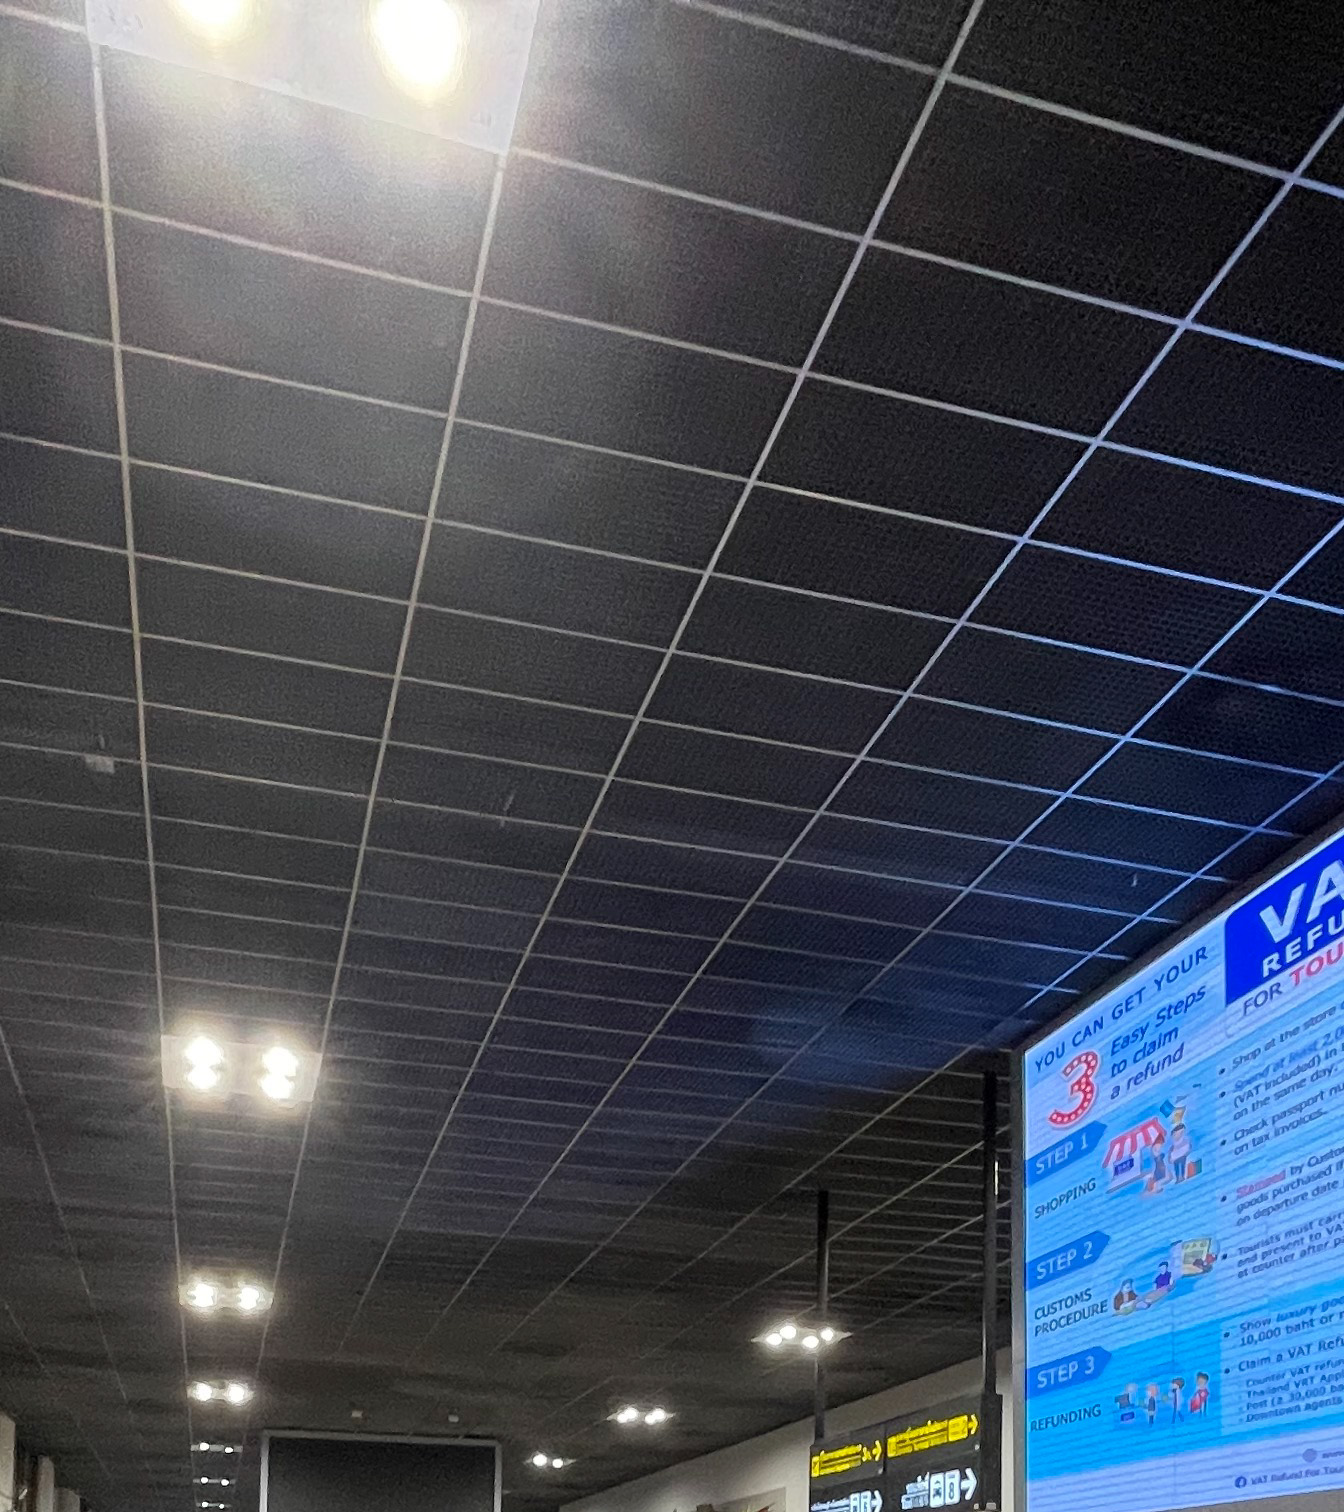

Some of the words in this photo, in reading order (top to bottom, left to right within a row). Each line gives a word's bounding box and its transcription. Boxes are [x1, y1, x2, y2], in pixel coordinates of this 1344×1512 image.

[1035, 1042, 1065, 1073] YOU
[1072, 1016, 1104, 1047] CAN
[1111, 986, 1146, 1021] GET
[1154, 946, 1208, 992] YOUR
[1242, 982, 1283, 1016] FOR
[1111, 1022, 1150, 1056] Easy
[1156, 985, 1207, 1027] Steps
[1111, 1061, 1127, 1078] to
[1133, 1026, 1179, 1063] claim
[1111, 1086, 1121, 1100] a
[1126, 1042, 1185, 1091] refund
[1048, 1050, 1100, 1128] 3
[1035, 1140, 1074, 1175] STEP
[1081, 1133, 1089, 1150] 1
[1034, 1177, 1096, 1219] SHOPPING
[1037, 1248, 1077, 1280] STEP
[1083, 1241, 1093, 1260] 2
[1034, 1288, 1092, 1320] CUSTOMS
[1034, 1299, 1108, 1337] PROCEDURE
[1037, 1360, 1079, 1389] STEP
[1085, 1355, 1095, 1375] 3
[1030, 1404, 1102, 1433] REFUNDING
